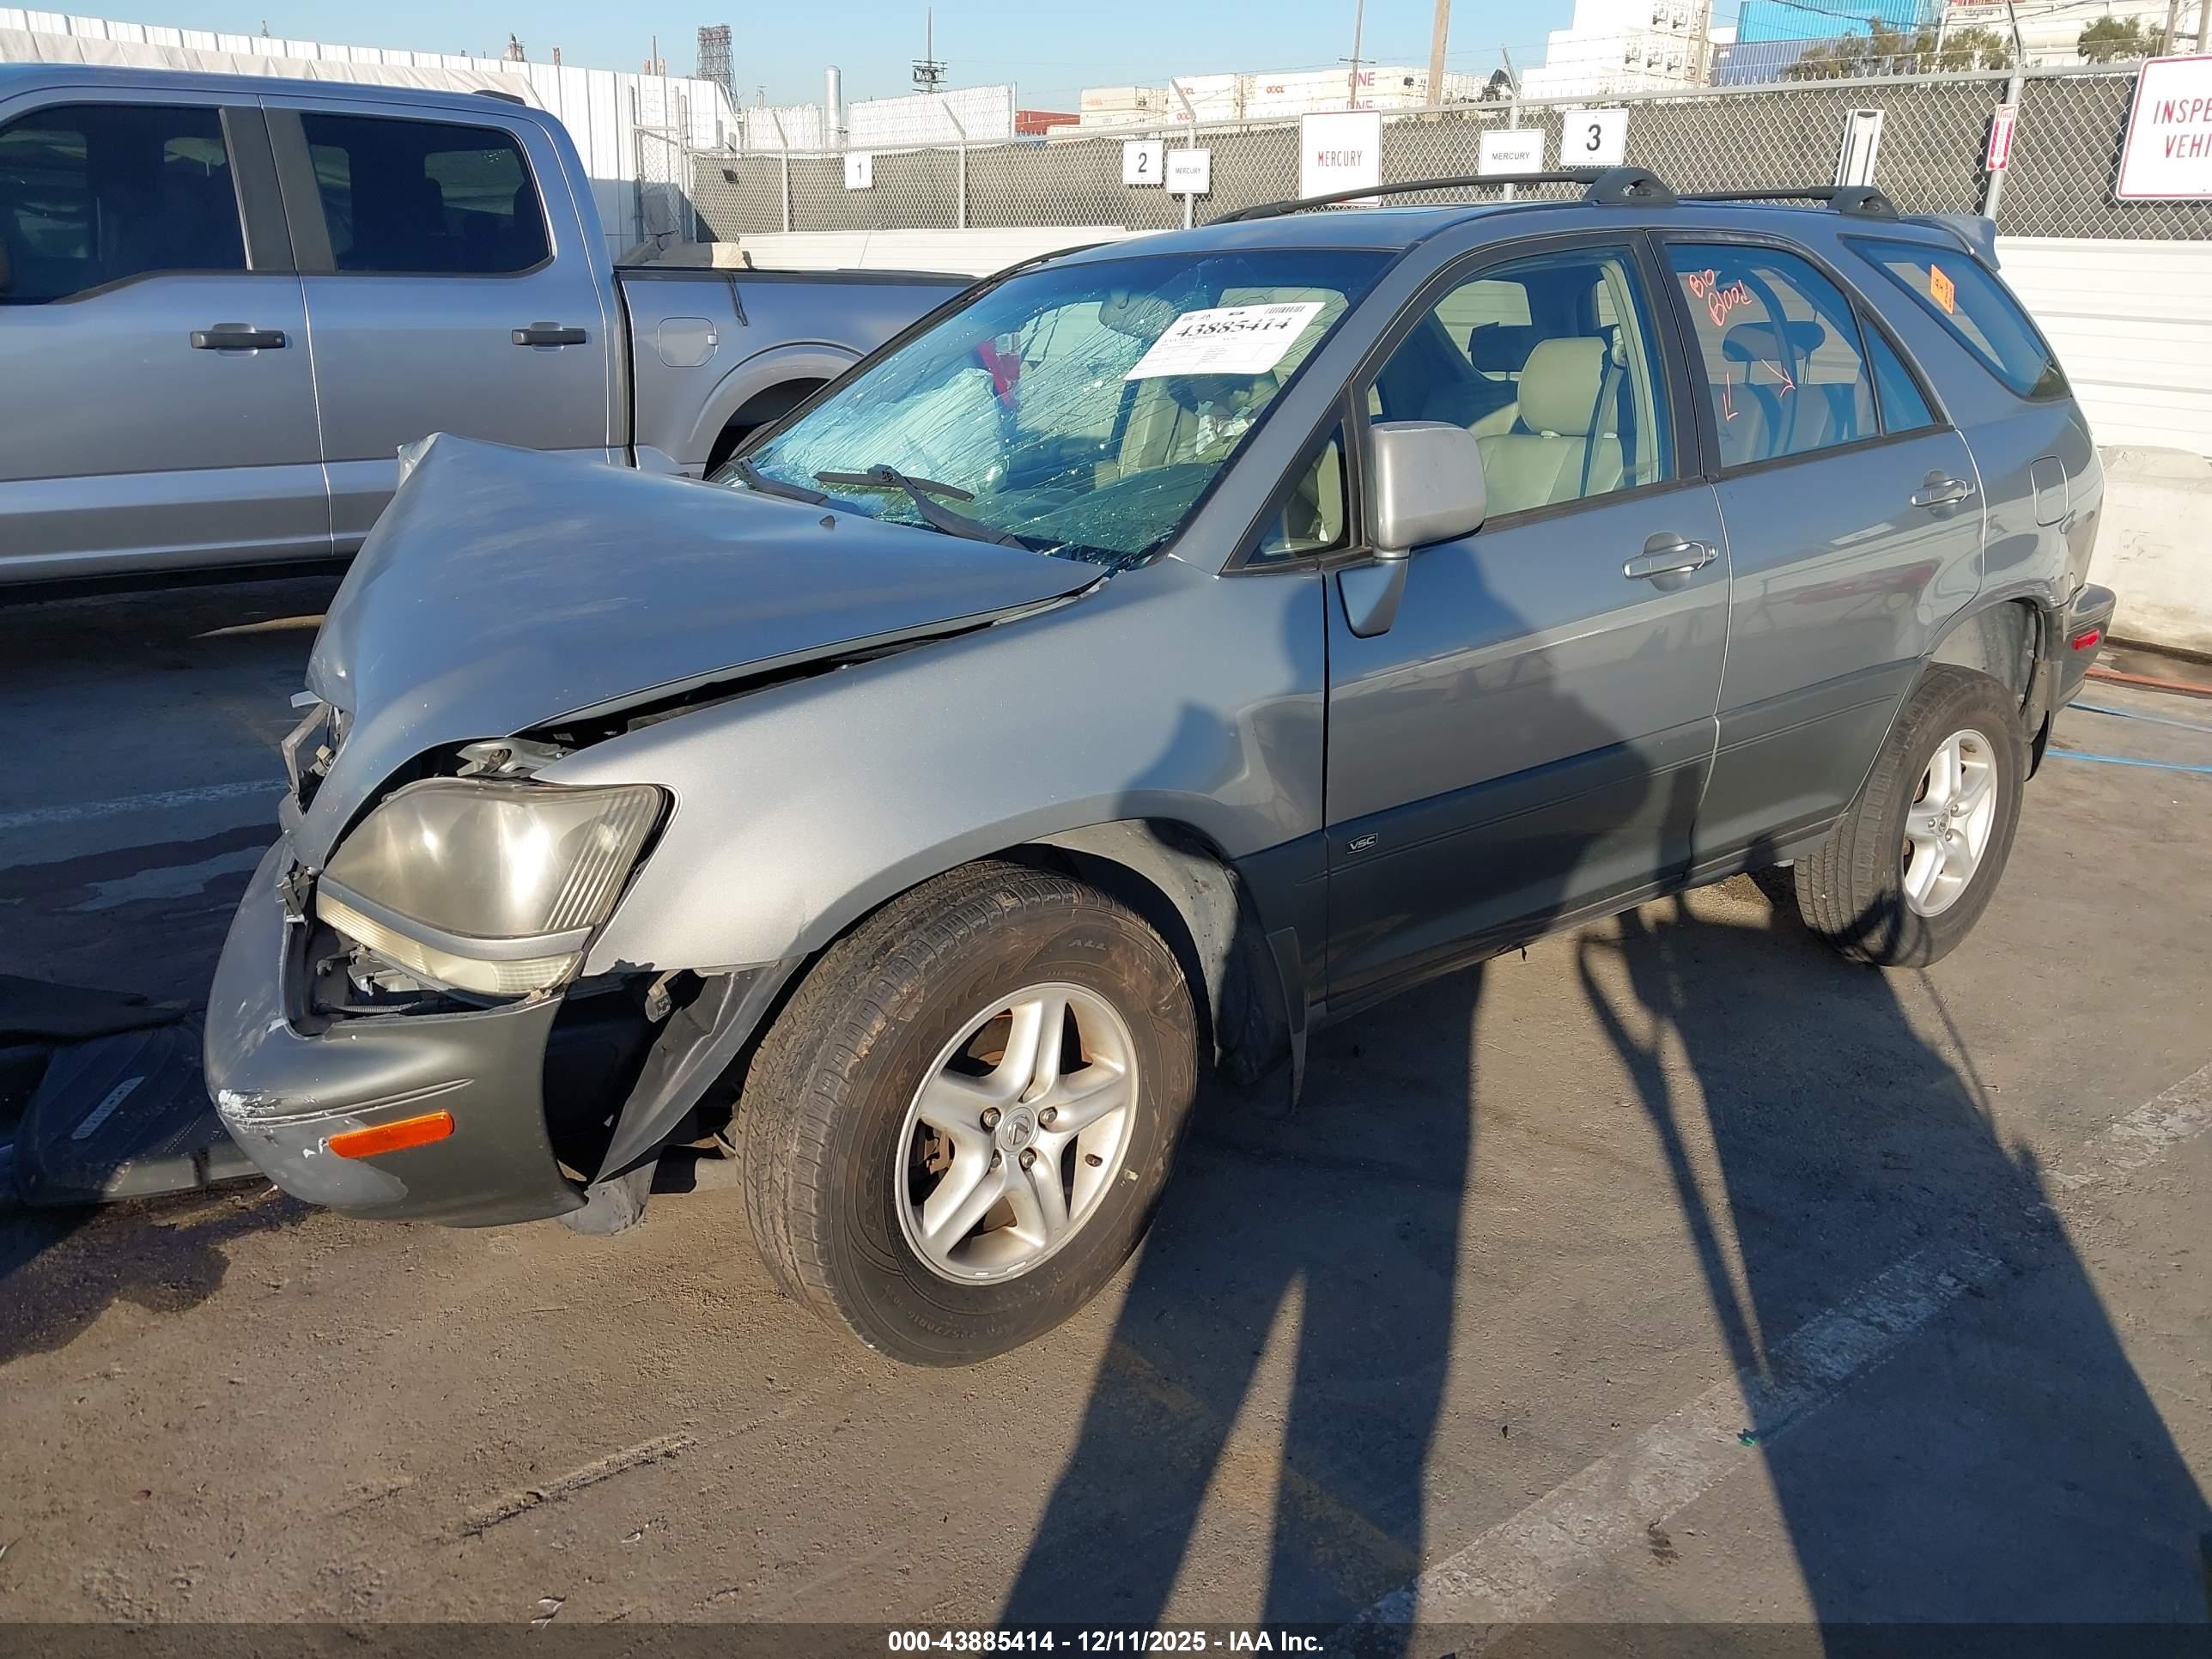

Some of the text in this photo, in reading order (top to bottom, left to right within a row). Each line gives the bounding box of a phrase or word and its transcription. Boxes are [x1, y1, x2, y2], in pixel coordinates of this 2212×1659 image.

[1586, 124, 1602, 152] 3
[1138, 152, 1147, 173] 2
[1317, 150, 1363, 167] MERCURY
[1492, 151, 1530, 161] MERCURY
[856, 161, 862, 179] 1
[1176, 317, 1291, 337] 43885414
[1349, 836, 1376, 850] VSC
